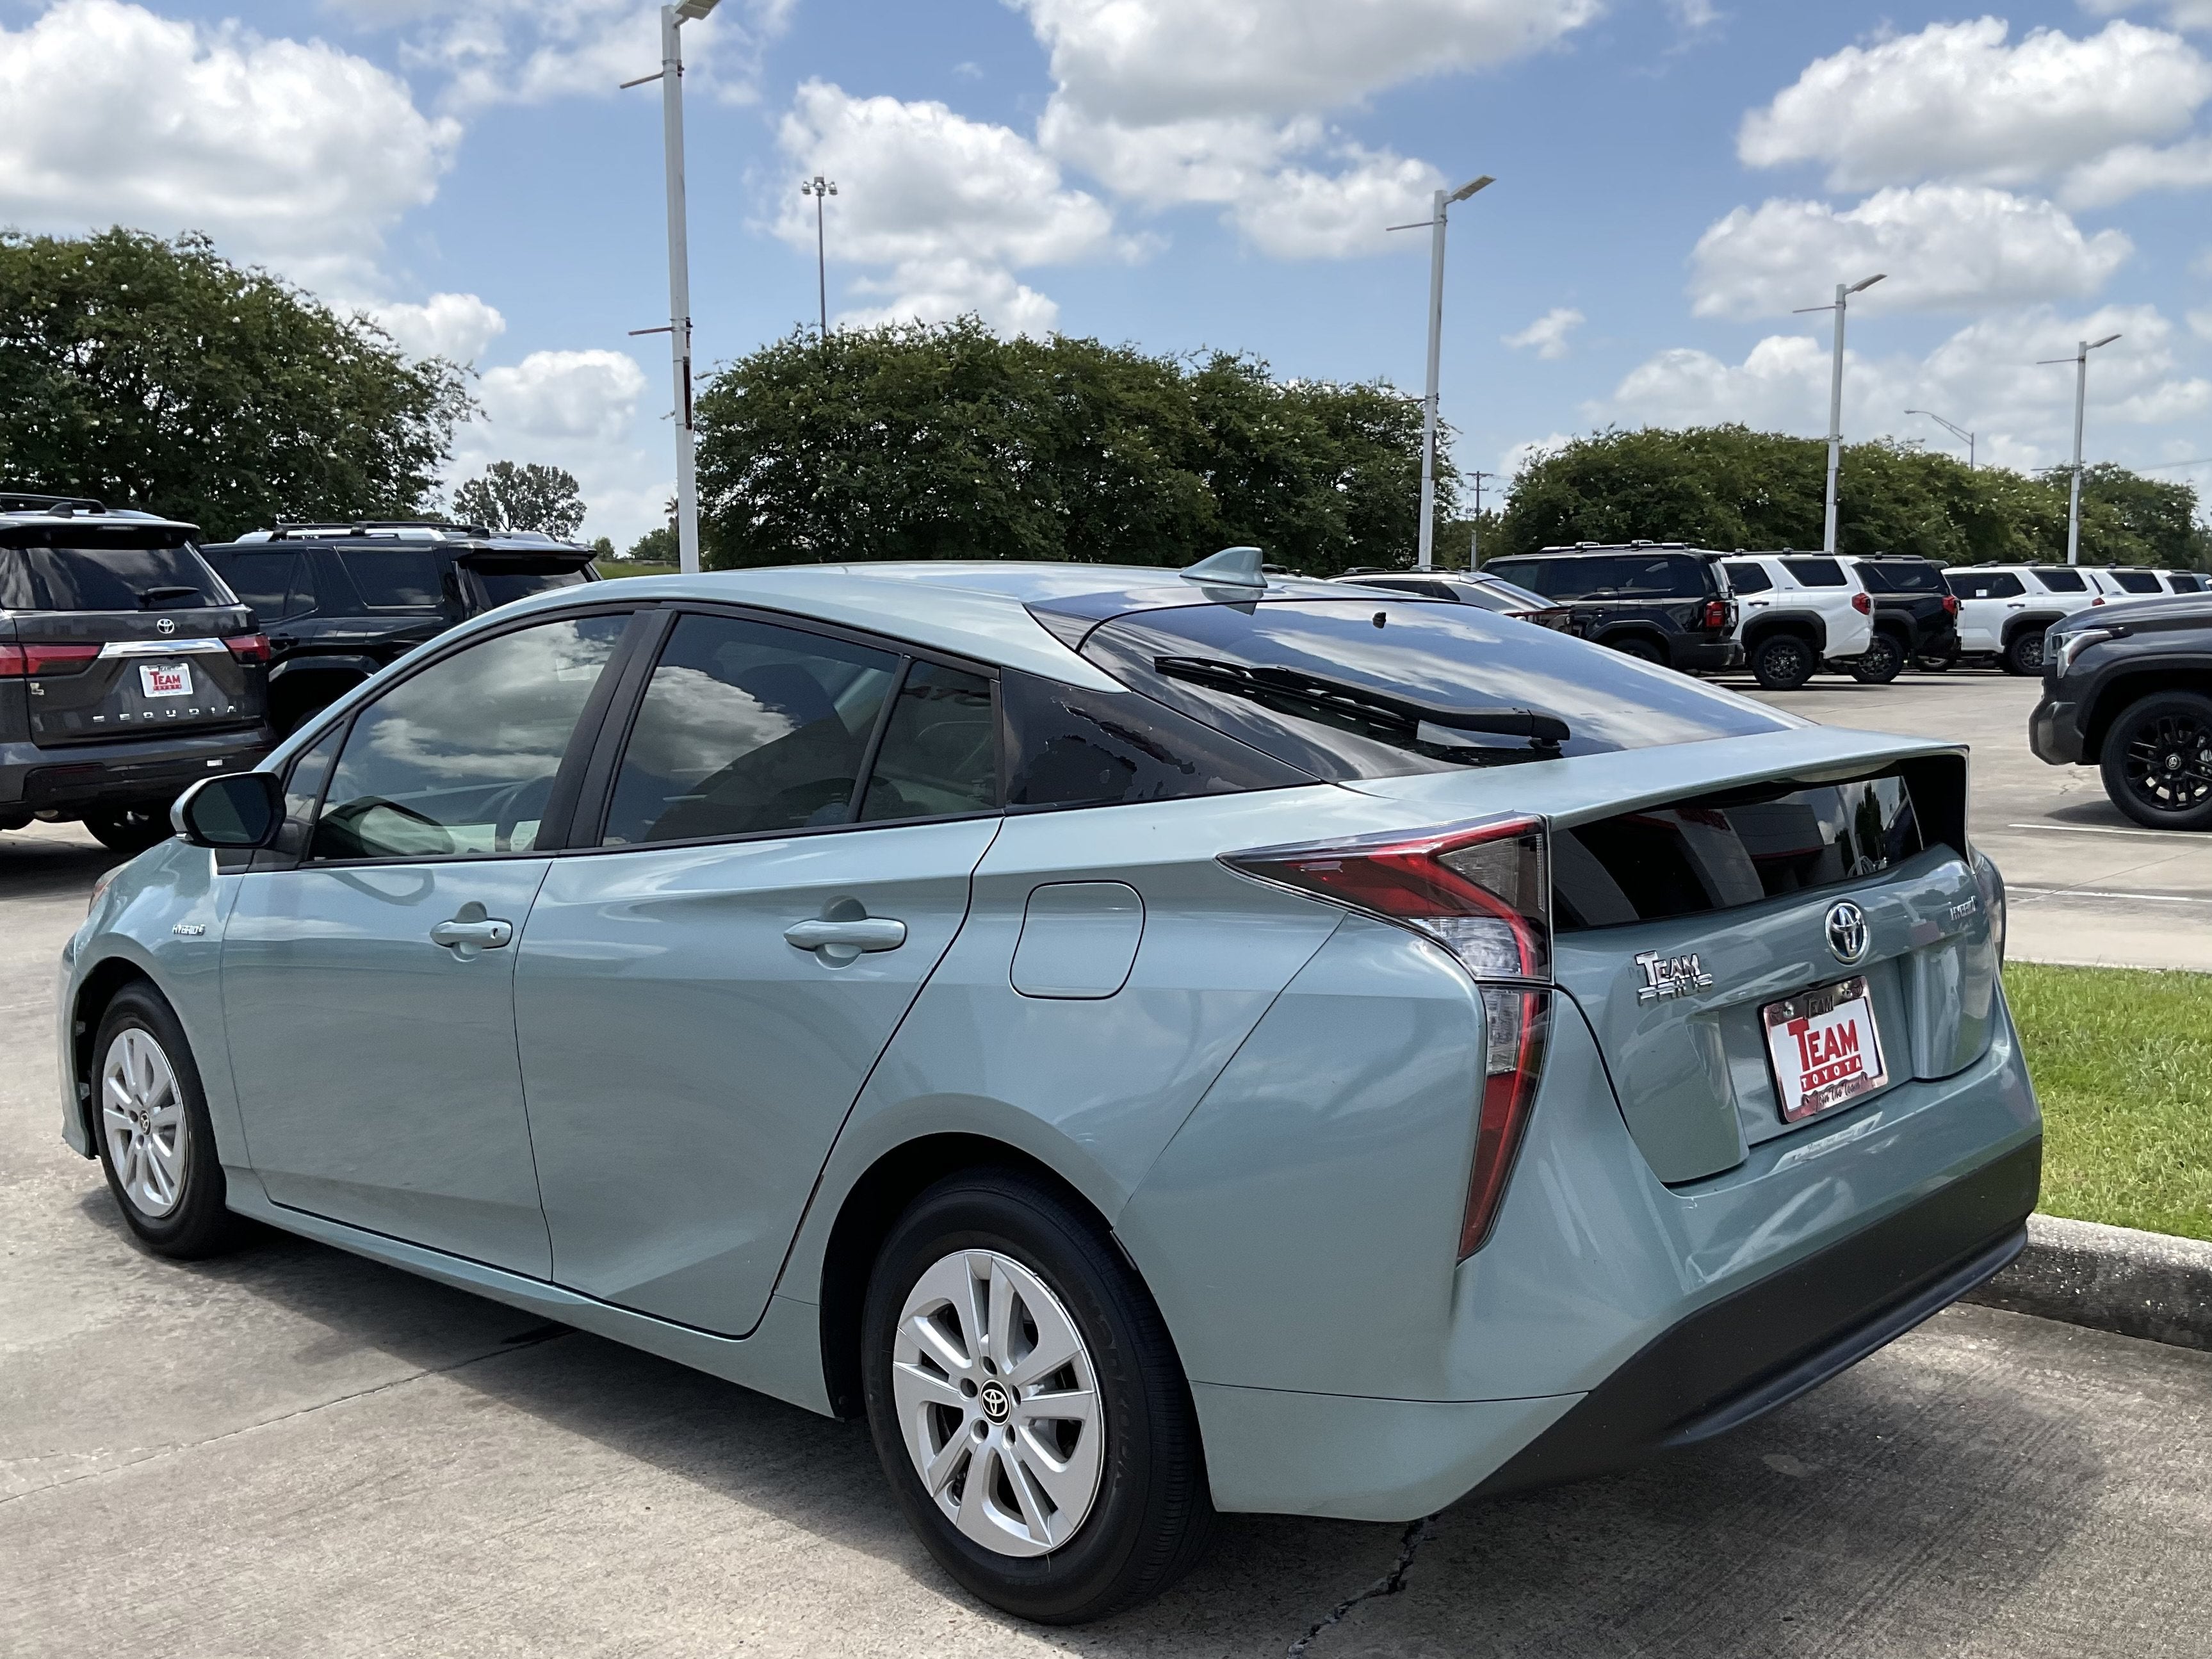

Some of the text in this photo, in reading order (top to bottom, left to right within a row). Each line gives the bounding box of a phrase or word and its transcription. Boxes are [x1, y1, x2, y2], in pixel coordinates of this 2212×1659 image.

[150, 671, 181, 685] TEAM
[1634, 950, 1701, 987] TEAM
[1787, 1018, 1859, 1072] TEAM
[1801, 1058, 1862, 1088] TOYOTA
